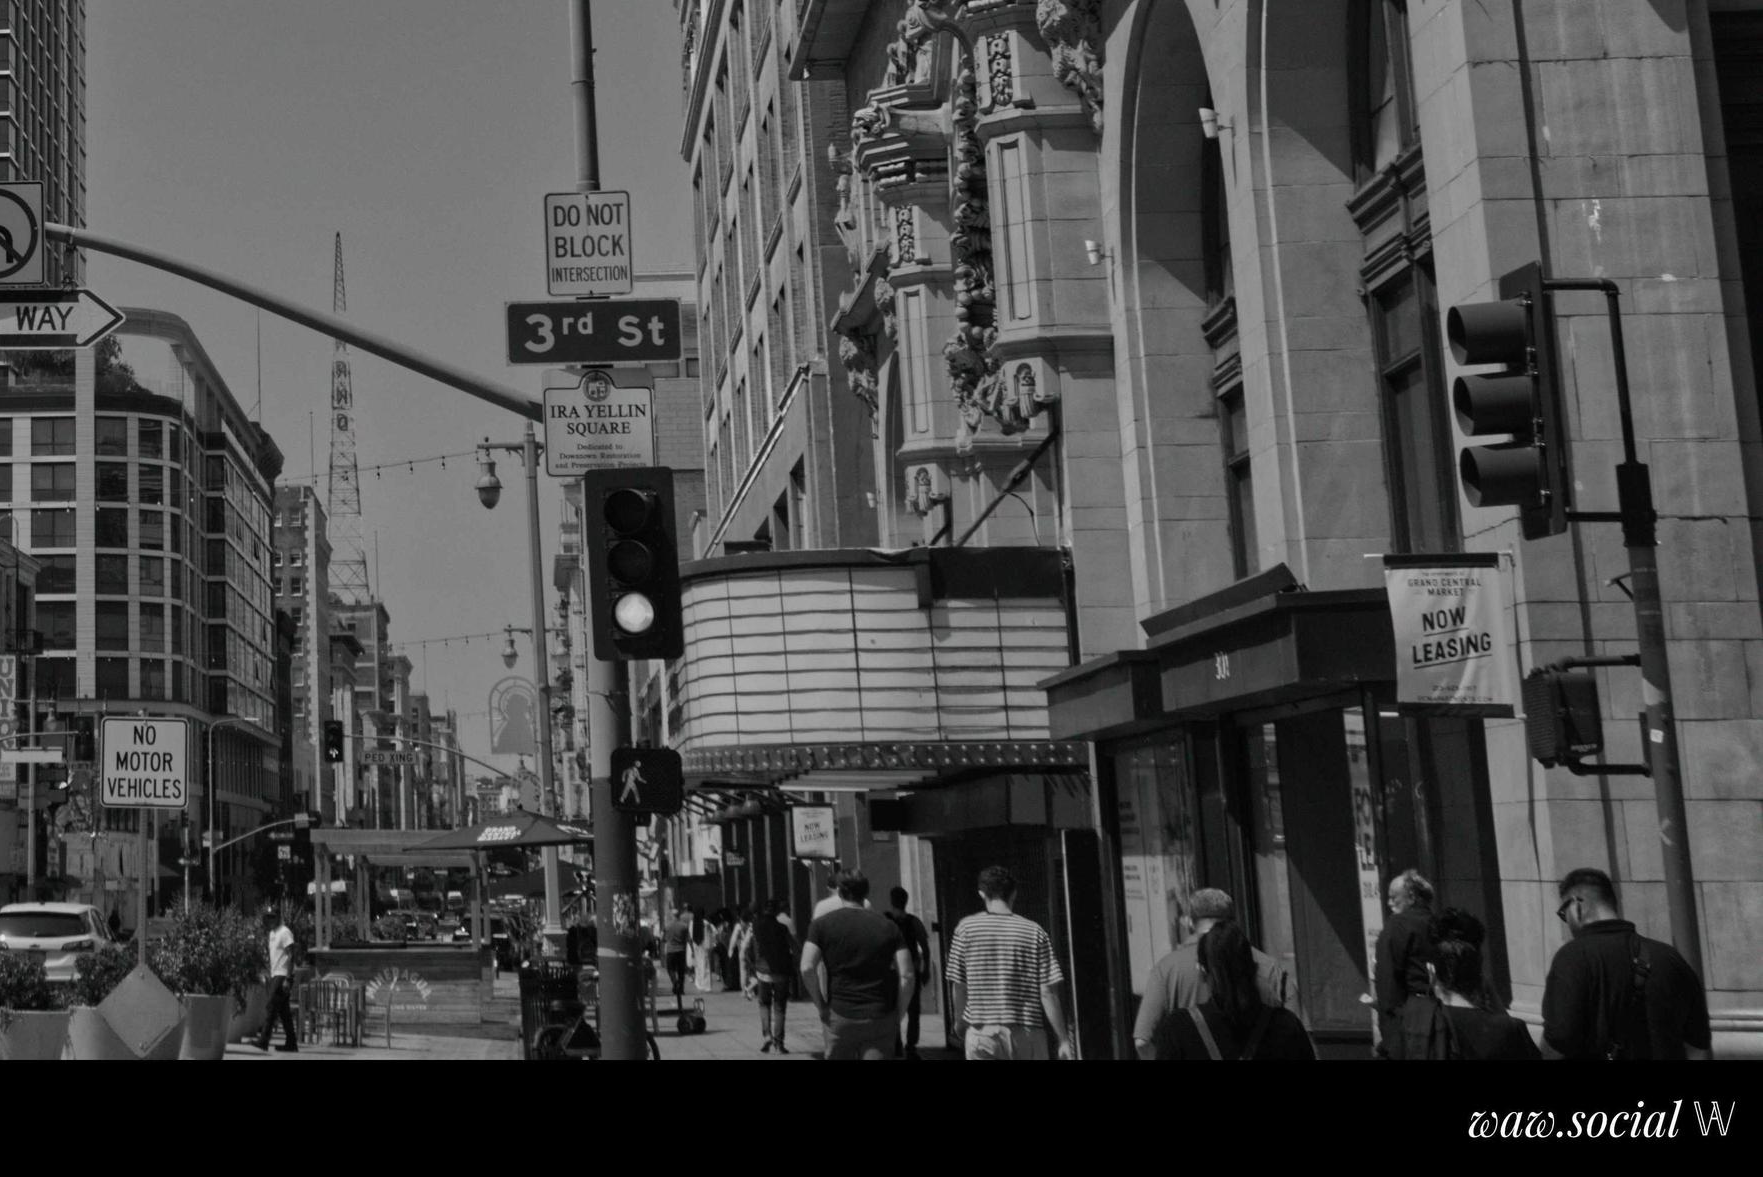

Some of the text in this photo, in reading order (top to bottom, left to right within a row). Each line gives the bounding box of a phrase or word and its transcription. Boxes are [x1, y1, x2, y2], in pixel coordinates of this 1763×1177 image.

[553, 203, 624, 228] DO NOT
[555, 234, 625, 258] BLOCK
[551, 265, 629, 283] INTERSECTION
[15, 306, 74, 331] WAY
[524, 312, 665, 353] 3rd St
[550, 404, 647, 419] IRA YELLIN
[567, 422, 631, 437] SQUARE
[559, 451, 641, 460] Downtown Restoration
[577, 442, 623, 451] Dedicated to
[1408, 578, 1482, 588] GRAND CENTRAL
[1427, 588, 1464, 597] MARKET
[1422, 606, 1466, 632] NOW
[1413, 632, 1492, 665] LEASING
[133, 725, 157, 748] NO
[115, 751, 174, 772] MOTOR
[364, 753, 414, 763] PED XING
[107, 777, 182, 801] VEHICLES
